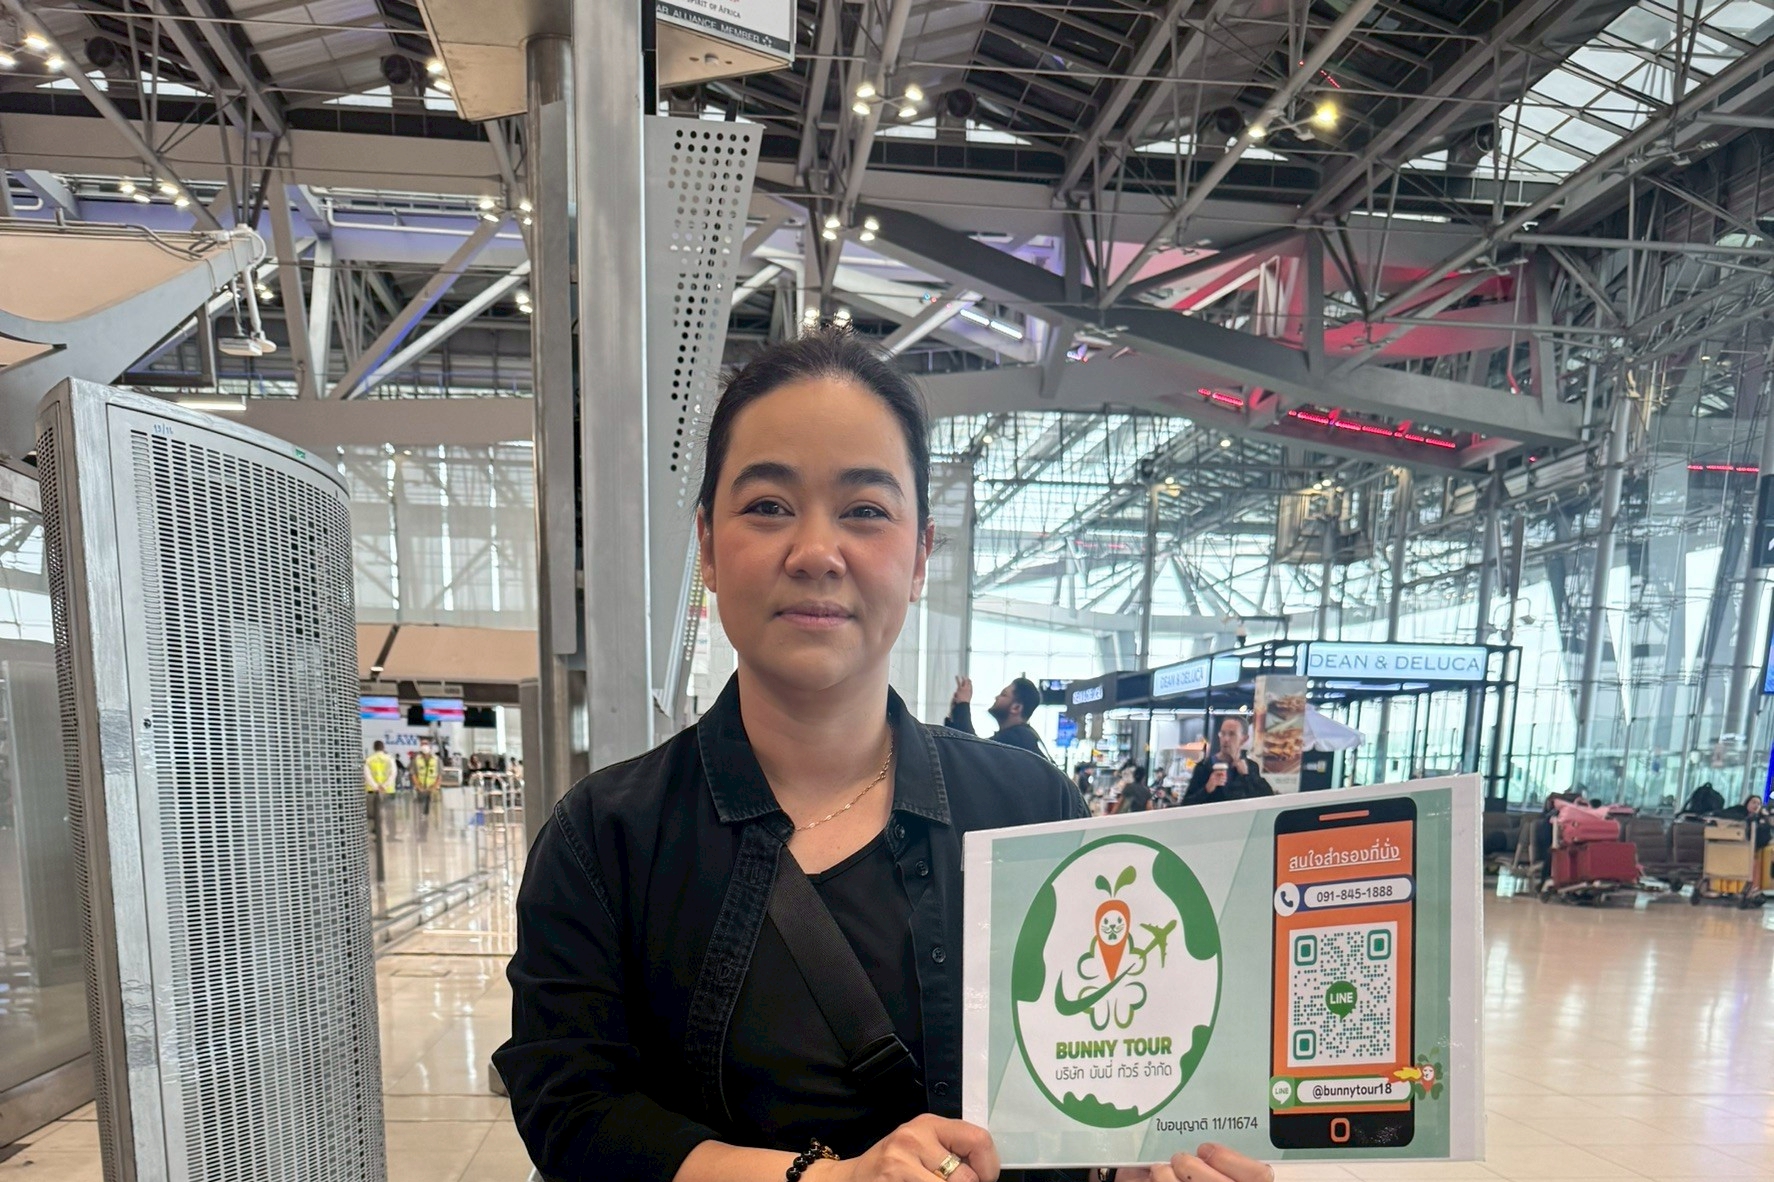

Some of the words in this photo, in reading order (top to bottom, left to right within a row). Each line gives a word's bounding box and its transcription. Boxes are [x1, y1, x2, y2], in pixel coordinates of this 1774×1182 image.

[672, 9, 717, 29] ALLIANCE
[720, 23, 760, 43] MEMBER
[1310, 654, 1368, 669] DEAN
[1375, 656, 1389, 669] &
[1395, 656, 1481, 672] DELUCA
[1289, 838, 1400, 869] สนใจสำรองที่นั่ง
[1316, 885, 1393, 902] 091-845-1888
[1330, 992, 1353, 1004] LINE
[1056, 1040, 1118, 1060] BUNNY
[1123, 1036, 1172, 1057] TOUR
[1056, 1065, 1084, 1080] บริษัท
[1090, 1060, 1113, 1079] บันนี่
[1118, 1062, 1139, 1078] ทัวร์
[1144, 1061, 1172, 1077] จำกัด
[1312, 1083, 1392, 1099] @bunnytour18
[1212, 1116, 1258, 1130] 11/11674
